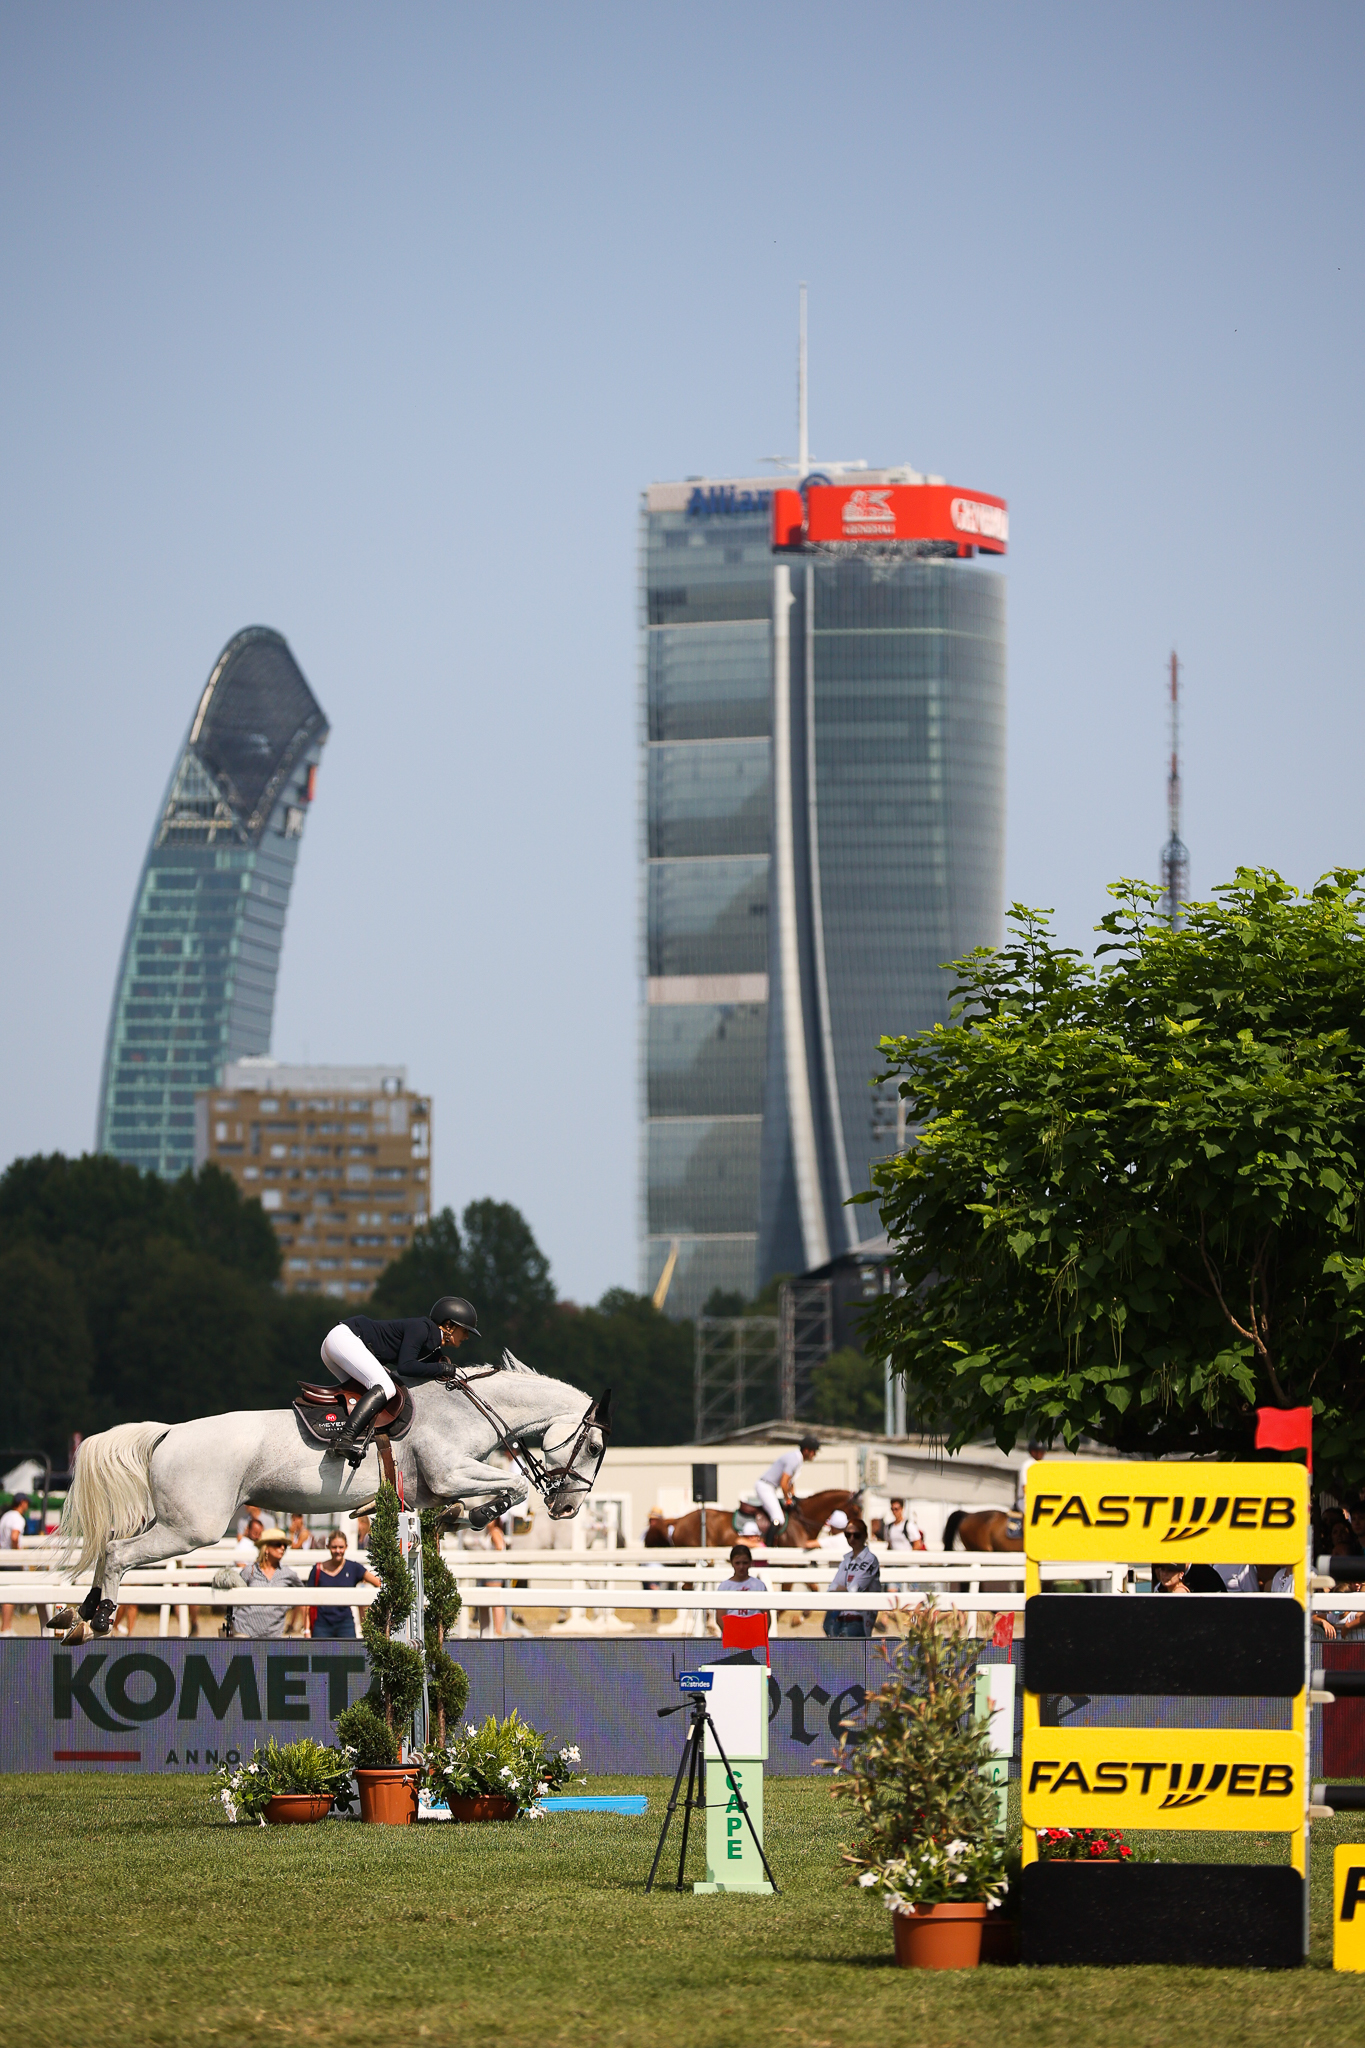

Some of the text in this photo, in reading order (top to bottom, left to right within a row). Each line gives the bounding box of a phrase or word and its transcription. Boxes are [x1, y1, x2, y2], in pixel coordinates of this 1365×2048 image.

[687, 484, 773, 515] Allian
[1030, 1494, 1296, 1542] FASTWEB
[53, 1652, 384, 1732] KOMET
[165, 1749, 241, 1764] ANNO
[1028, 1761, 1294, 1809] FASTWEB
[725, 1770, 744, 1859] CAPE
